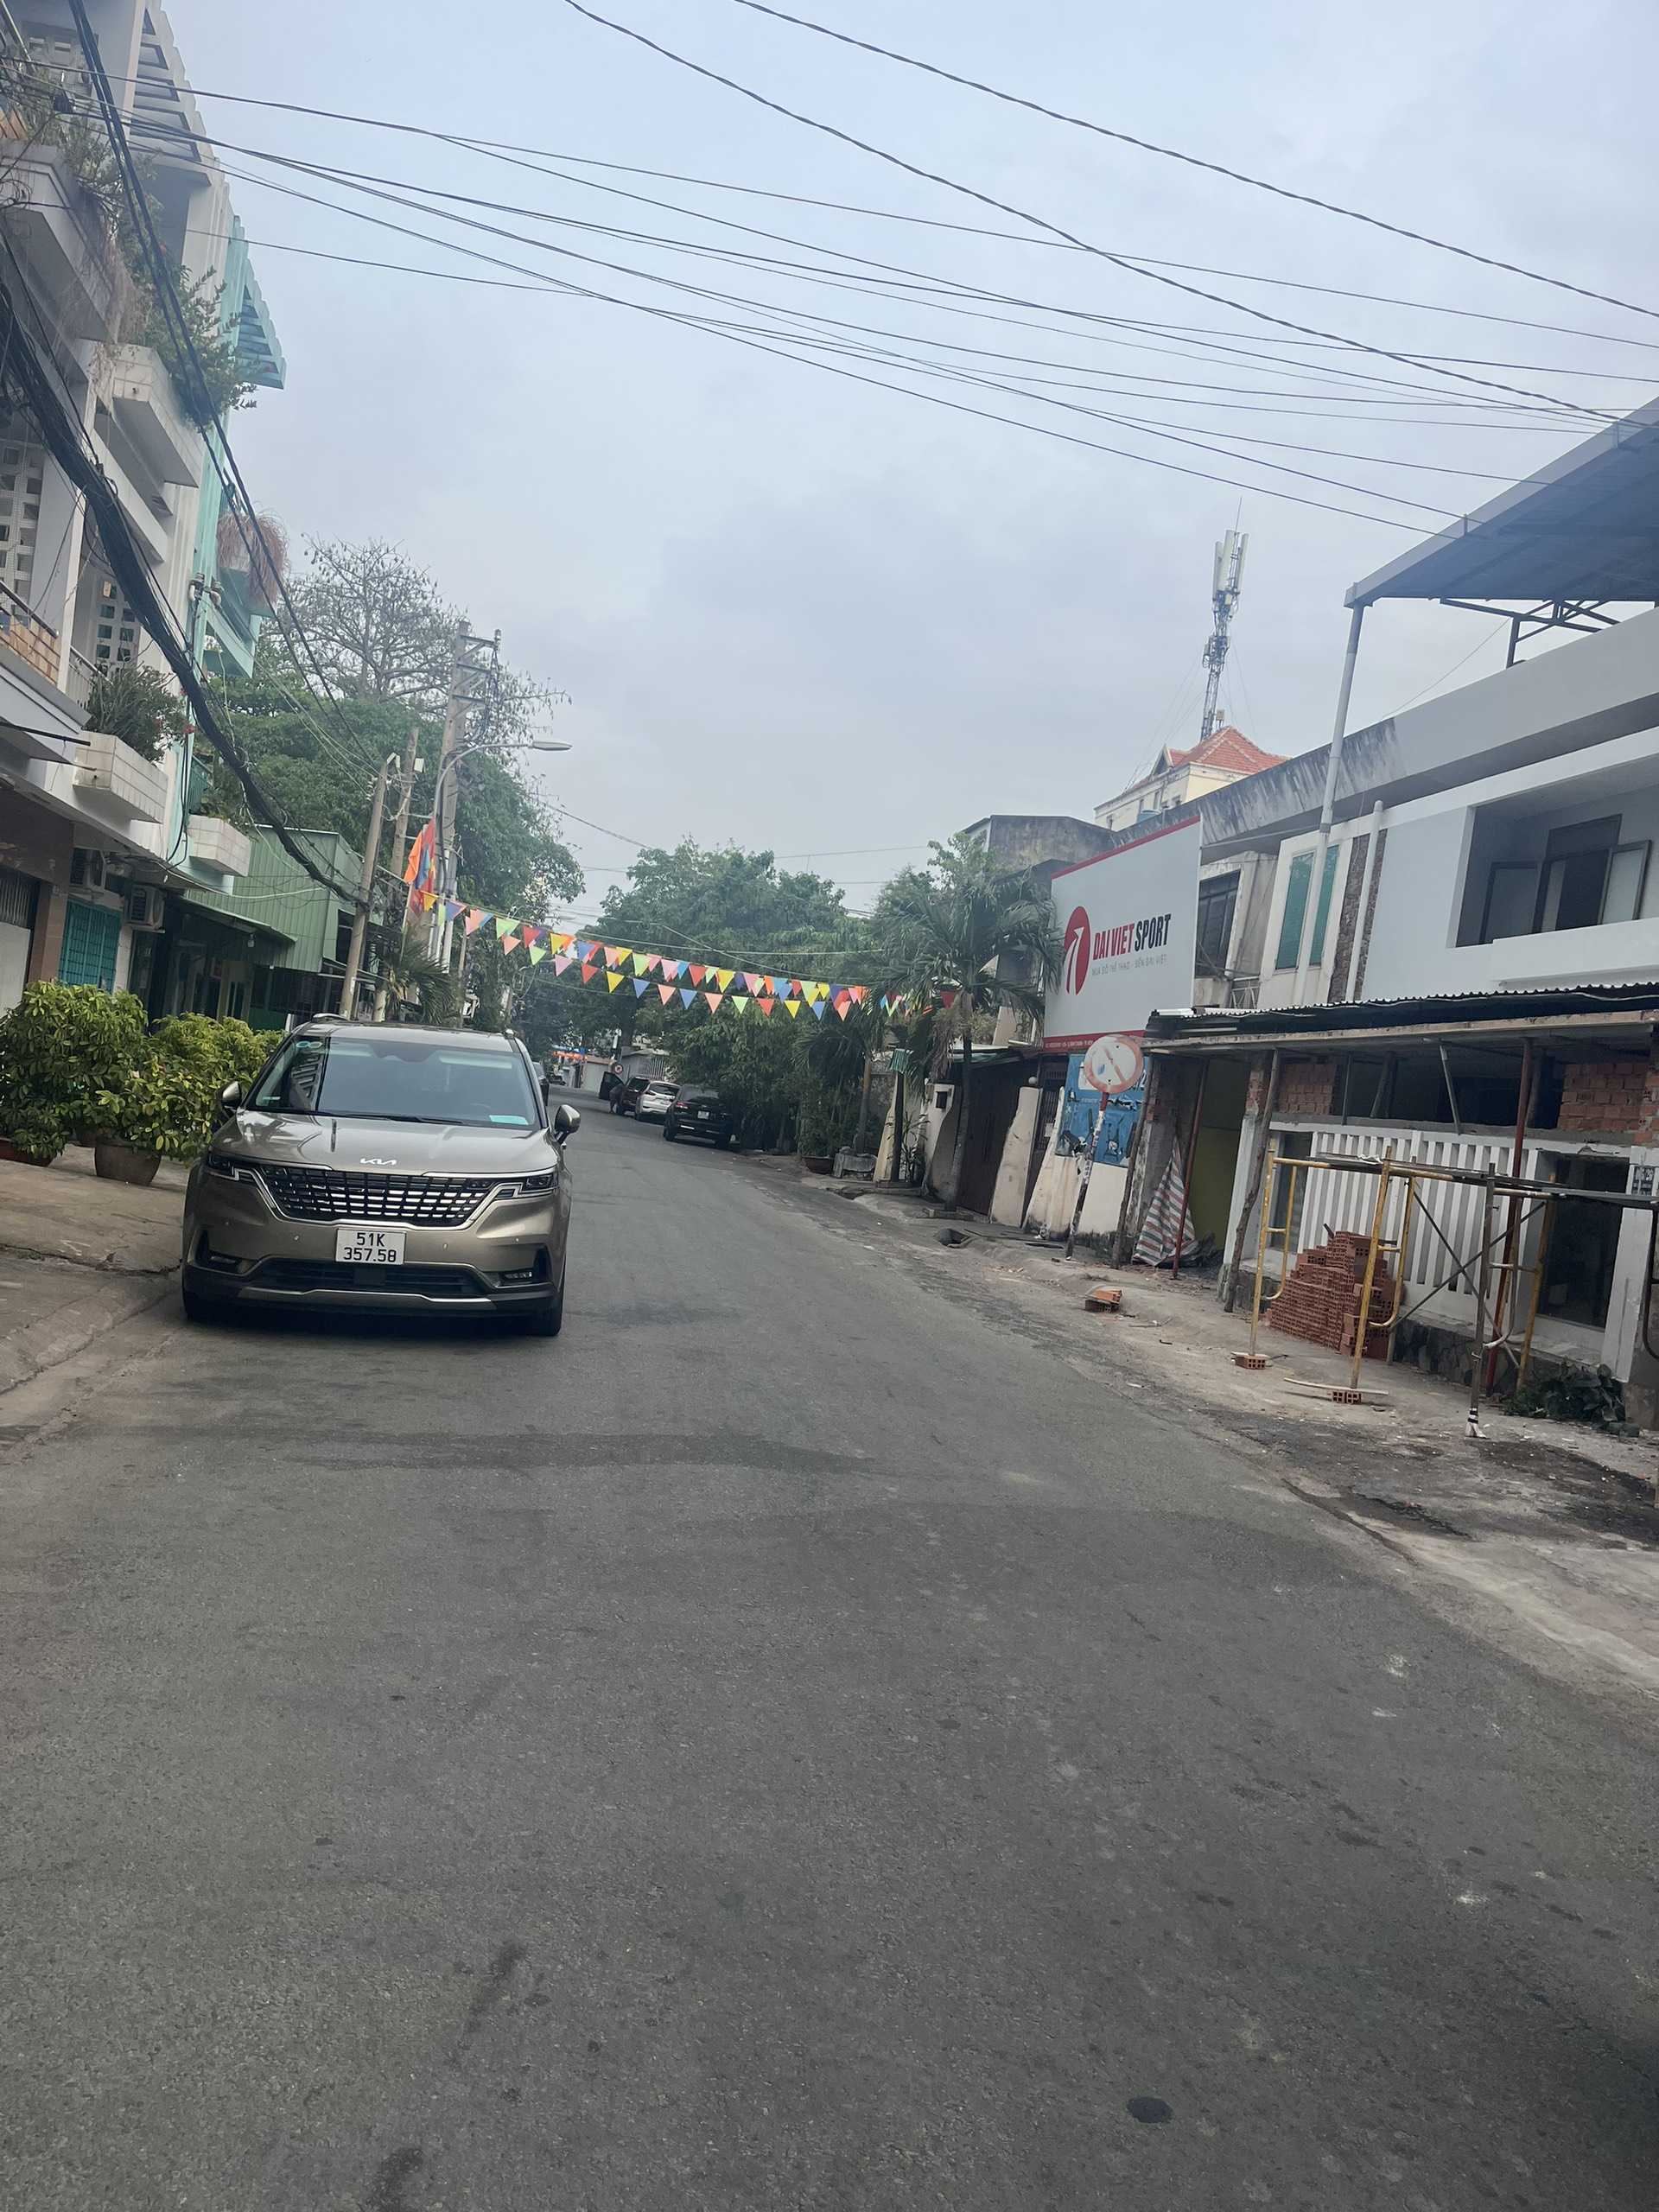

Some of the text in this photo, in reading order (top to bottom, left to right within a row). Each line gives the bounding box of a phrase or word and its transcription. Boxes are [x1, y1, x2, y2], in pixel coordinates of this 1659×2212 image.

[1092, 913, 1172, 961] DAI VIET SPORT
[356, 1232, 385, 1247] 51K
[343, 1247, 397, 1262] 357.58
